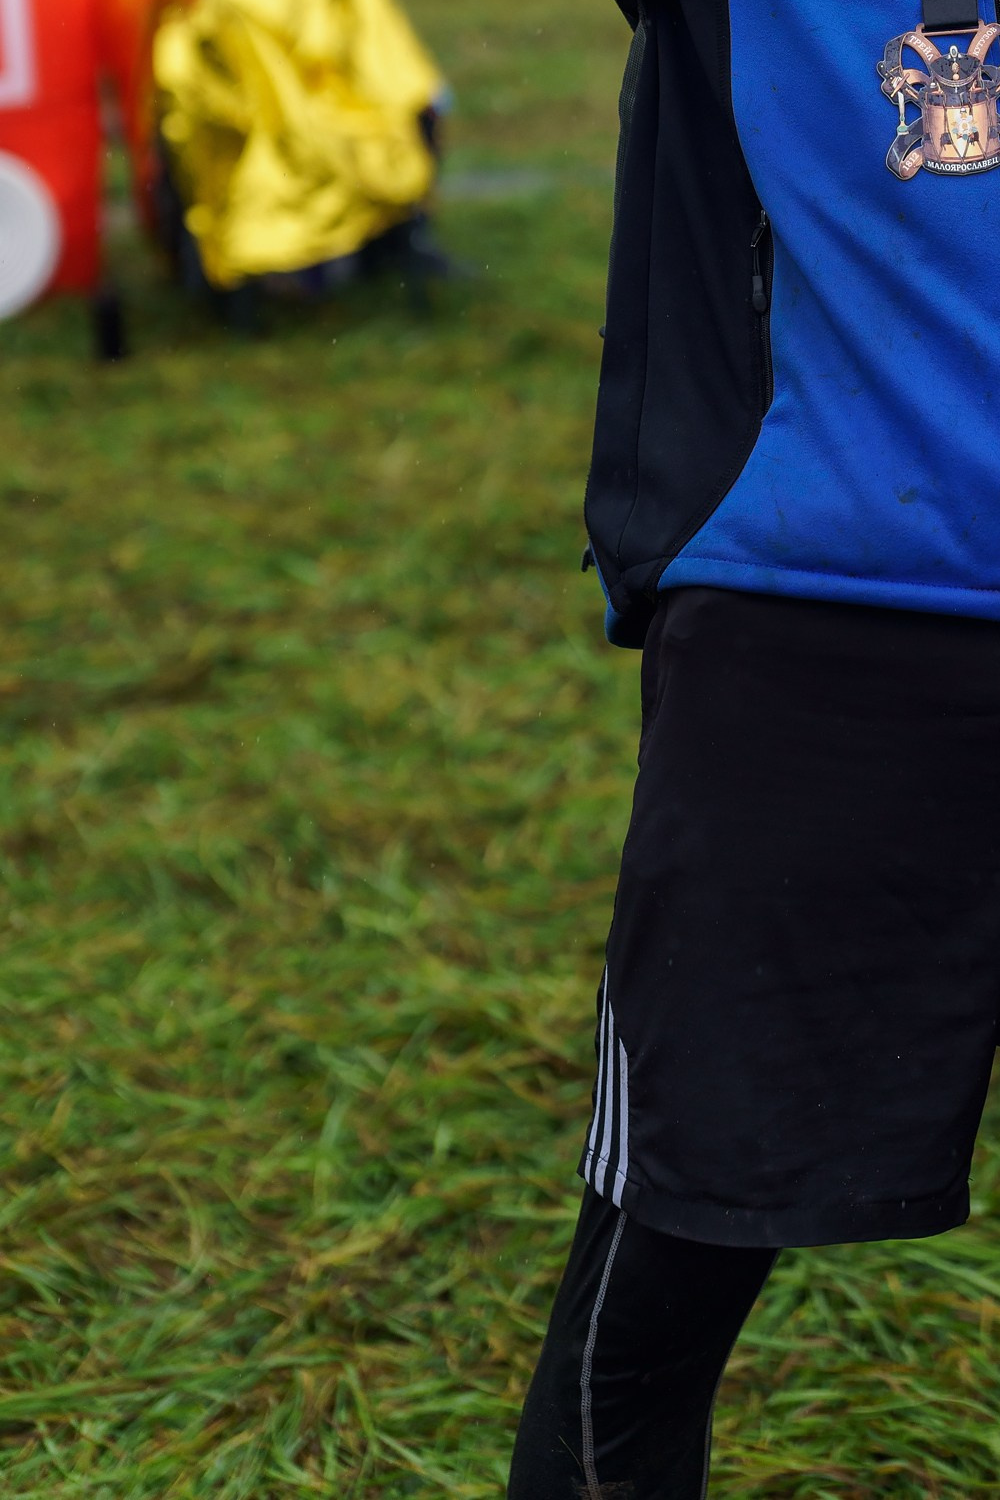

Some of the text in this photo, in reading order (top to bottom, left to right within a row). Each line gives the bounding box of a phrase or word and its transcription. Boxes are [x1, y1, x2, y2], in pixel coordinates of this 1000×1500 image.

[908, 35, 934, 61] ТРЕЙЛ
[973, 26, 998, 57] КУТУЗОВ
[902, 152, 920, 171] 1812
[927, 156, 999, 171] МАЛОЯРОСЛАВЕЦ
